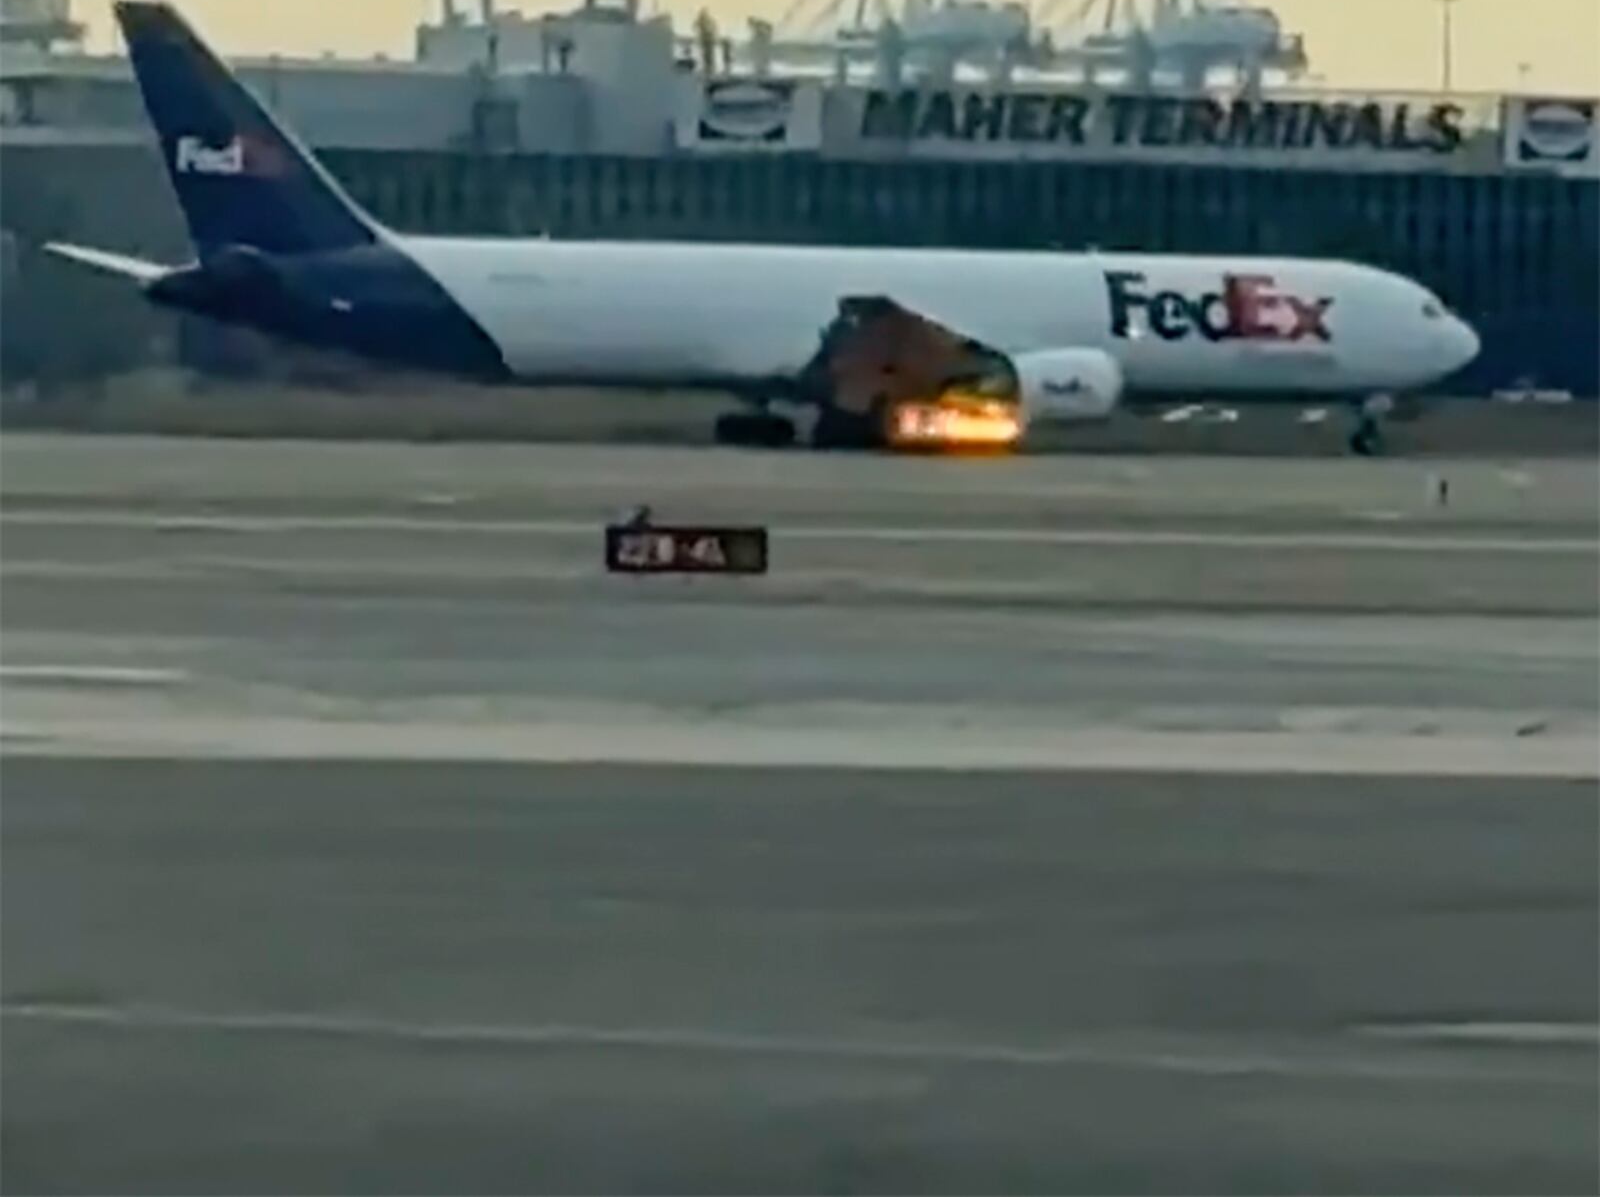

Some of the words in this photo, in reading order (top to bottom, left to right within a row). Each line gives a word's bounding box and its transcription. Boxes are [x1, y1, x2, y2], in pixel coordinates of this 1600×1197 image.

[862, 90, 1089, 145] MAHER
[1107, 96, 1464, 154] TERMINALS
[177, 136, 284, 175] Fed
[1103, 270, 1335, 342] FedEx
